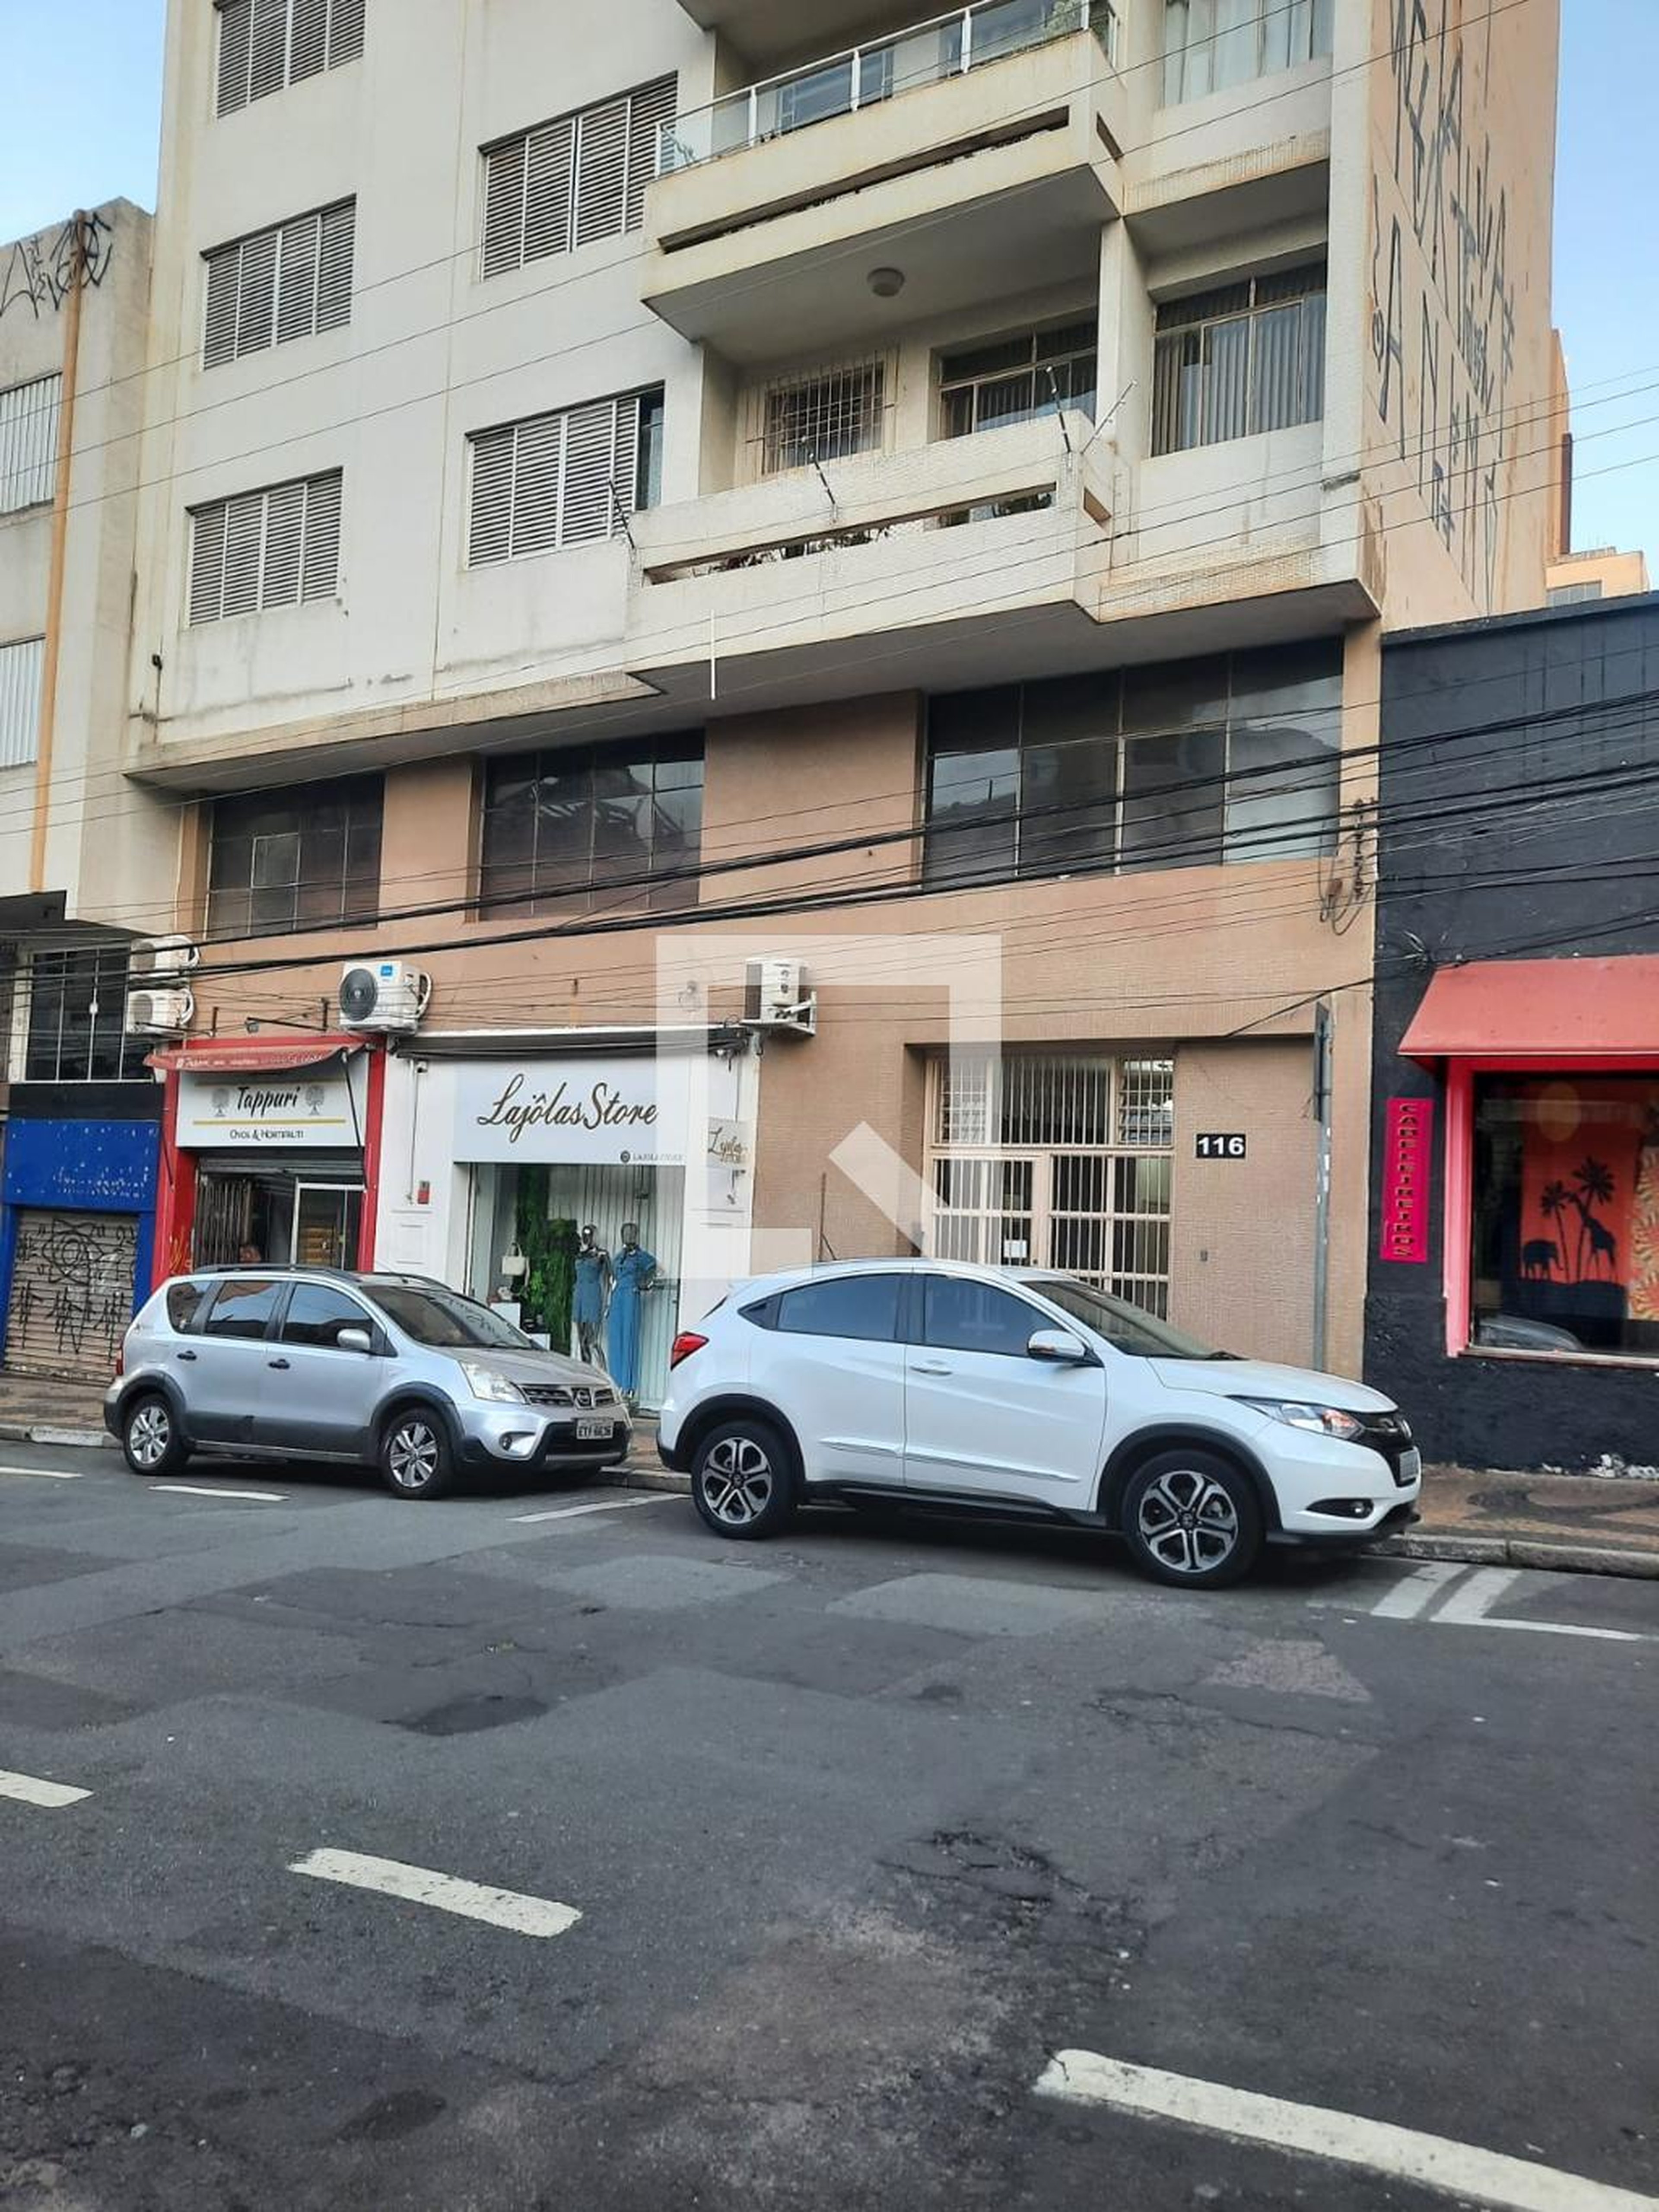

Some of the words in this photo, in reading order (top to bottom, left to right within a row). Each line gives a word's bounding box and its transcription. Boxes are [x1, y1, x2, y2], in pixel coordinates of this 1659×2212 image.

[238, 1085, 300, 1117] Tappuri
[584, 1082, 658, 1130] Store
[1198, 1136, 1244, 1155] 116
